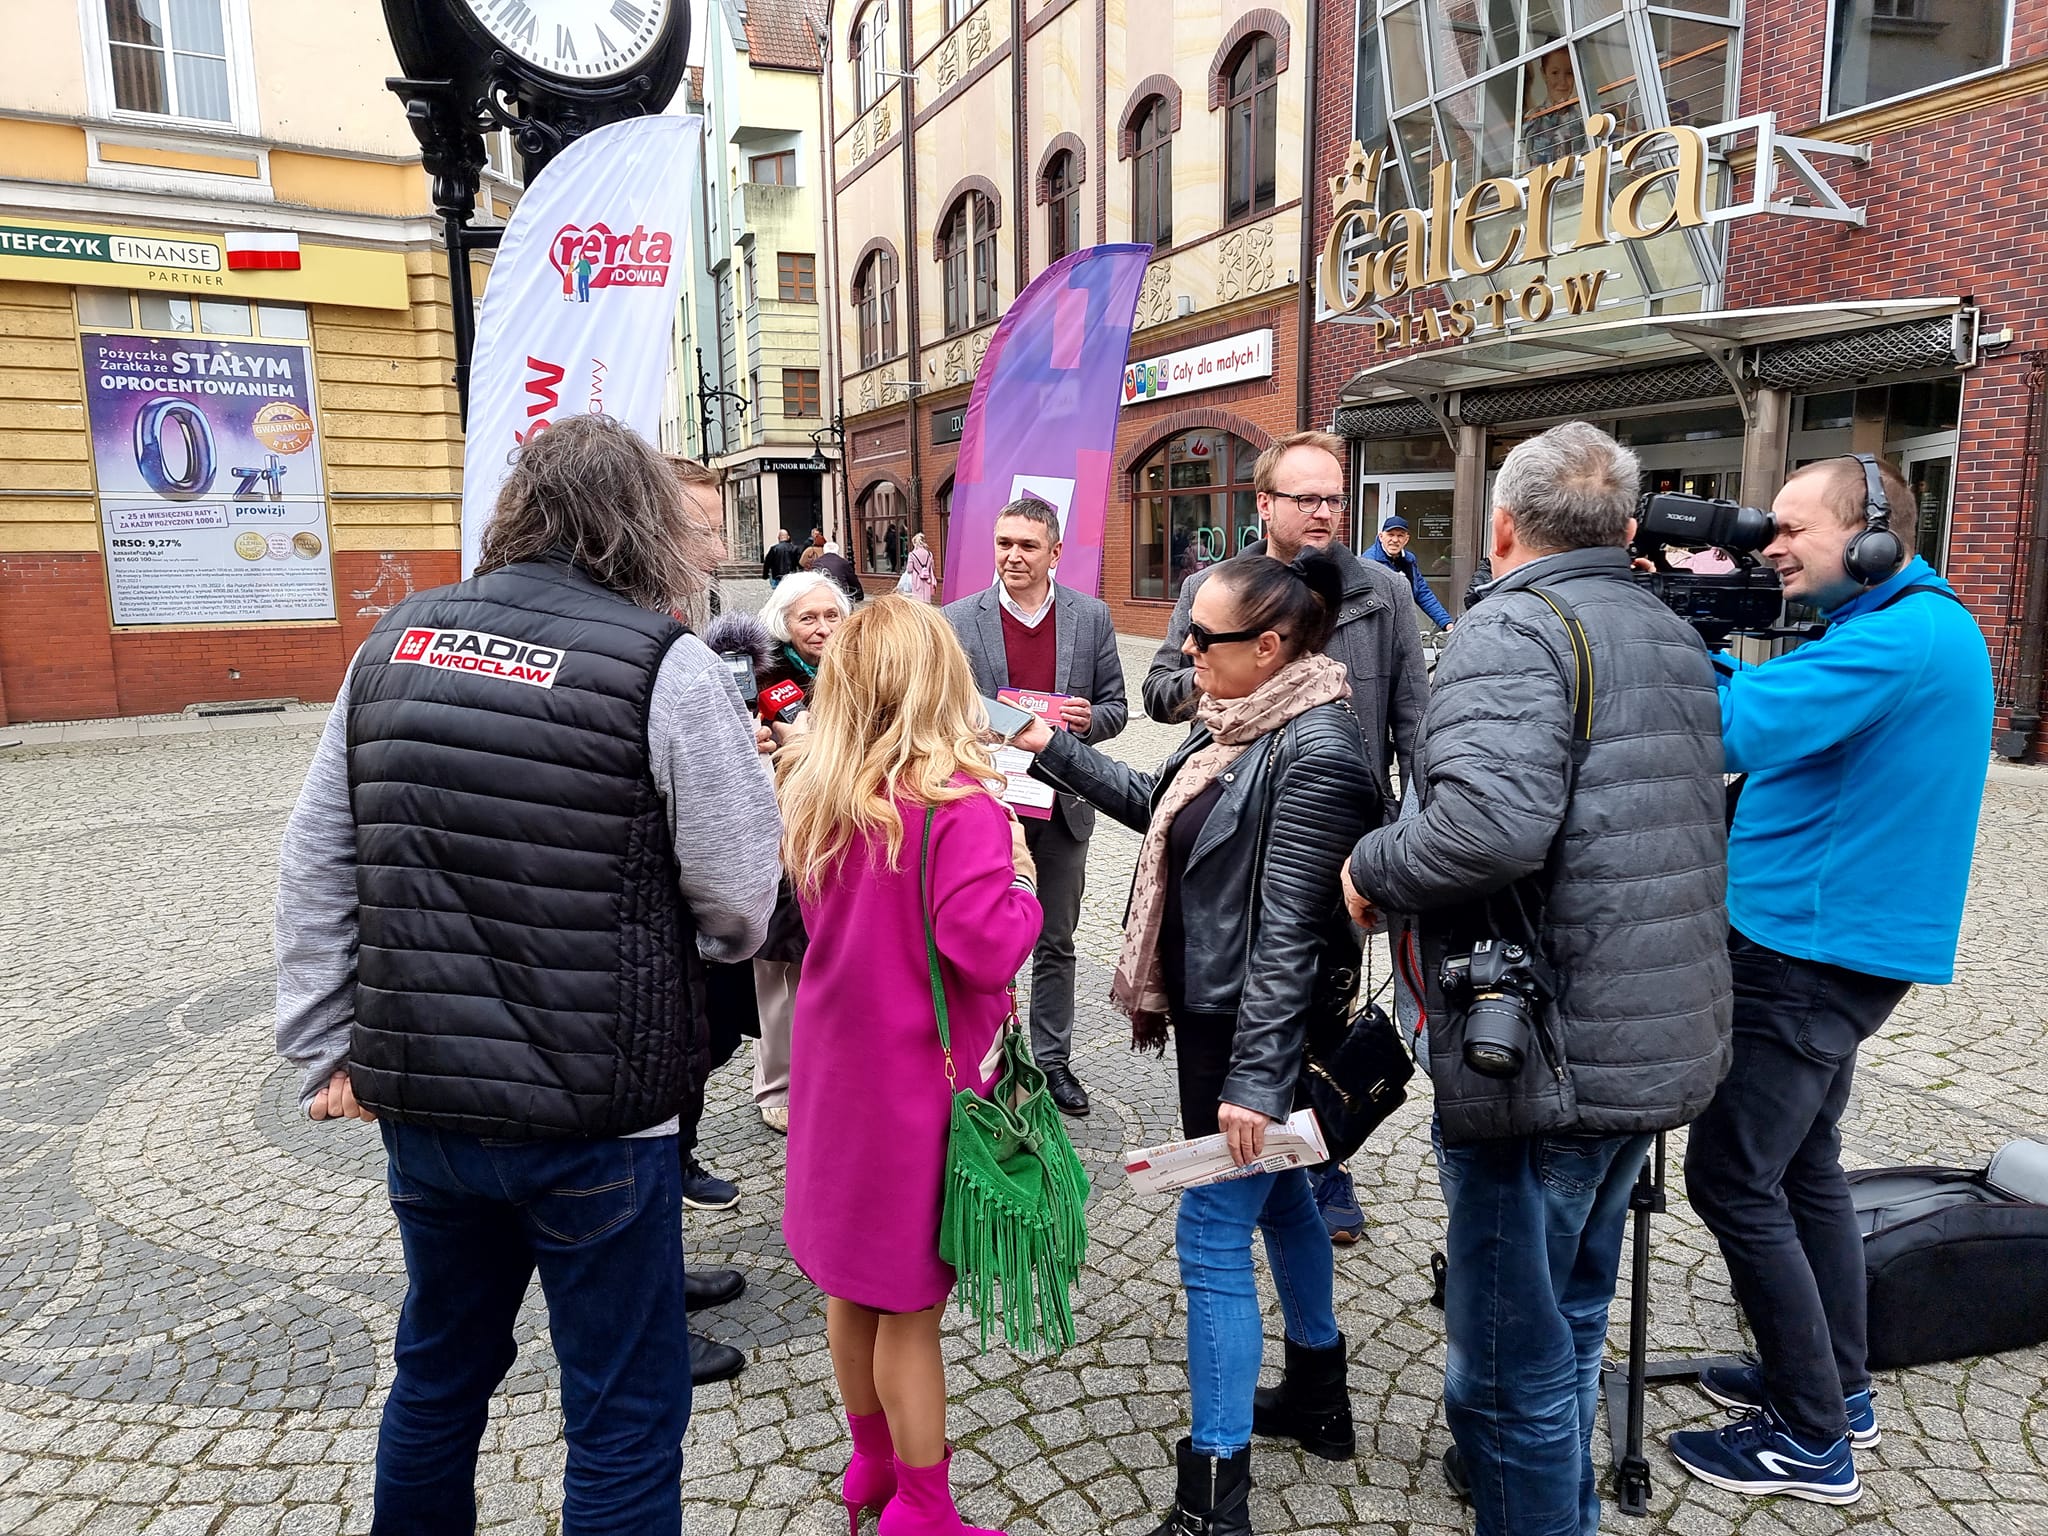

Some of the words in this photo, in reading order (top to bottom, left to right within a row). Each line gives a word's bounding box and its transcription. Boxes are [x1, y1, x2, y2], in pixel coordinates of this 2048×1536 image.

[1323, 113, 1707, 313] Galeria
[118, 242, 210, 265] FINANSE
[560, 224, 672, 265] renta
[149, 271, 223, 286] PARTNER
[1375, 269, 1608, 354] PIASTÓW
[99, 347, 167, 361] Pożyczka
[101, 360, 150, 372] Zaratka
[154, 364, 168, 373] ze
[172, 352, 292, 379] STAŁYM
[1173, 362, 1193, 383] Cały
[1197, 357, 1213, 375] dla
[1217, 347, 1253, 373] małych
[100, 375, 295, 398] OPROCENTOWANIEM
[255, 422, 310, 434] GWARANCJA
[133, 396, 217, 502] 0
[232, 454, 287, 502] zł
[272, 438, 303, 450] RATY
[772, 463, 798, 471] JUNIOR
[128, 512, 138, 520] 25
[236, 505, 286, 517] prowizji
[195, 517, 215, 525] 1000
[112, 539, 145, 548] RRSO:
[148, 539, 182, 549] 9,27%
[433, 633, 558, 669] RADIO
[429, 652, 551, 682] WROCŁAW
